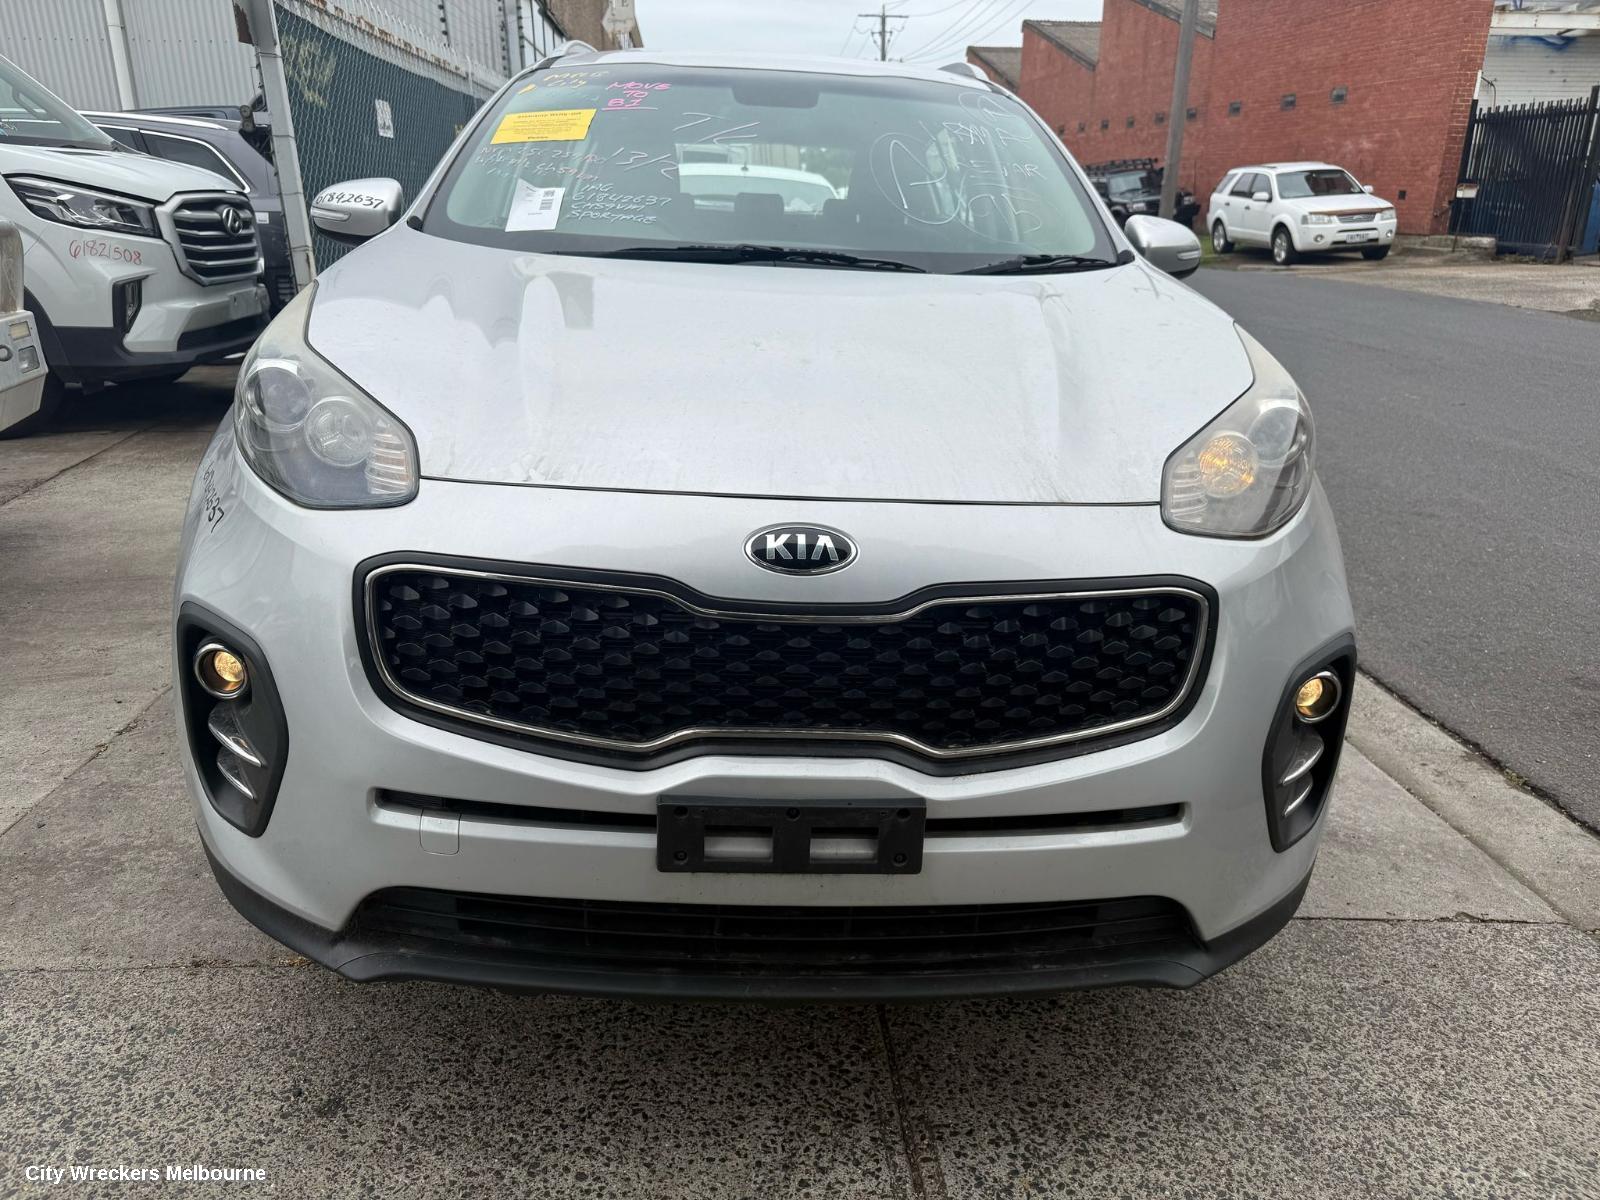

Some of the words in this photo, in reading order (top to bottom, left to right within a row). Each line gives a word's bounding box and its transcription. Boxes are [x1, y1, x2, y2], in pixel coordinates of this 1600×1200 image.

[605, 81, 671, 91] MOVE
[623, 90, 648, 98] TO
[572, 192, 672, 206] 61842637
[69, 239, 142, 266] 61821508
[765, 533, 839, 561] KIA
